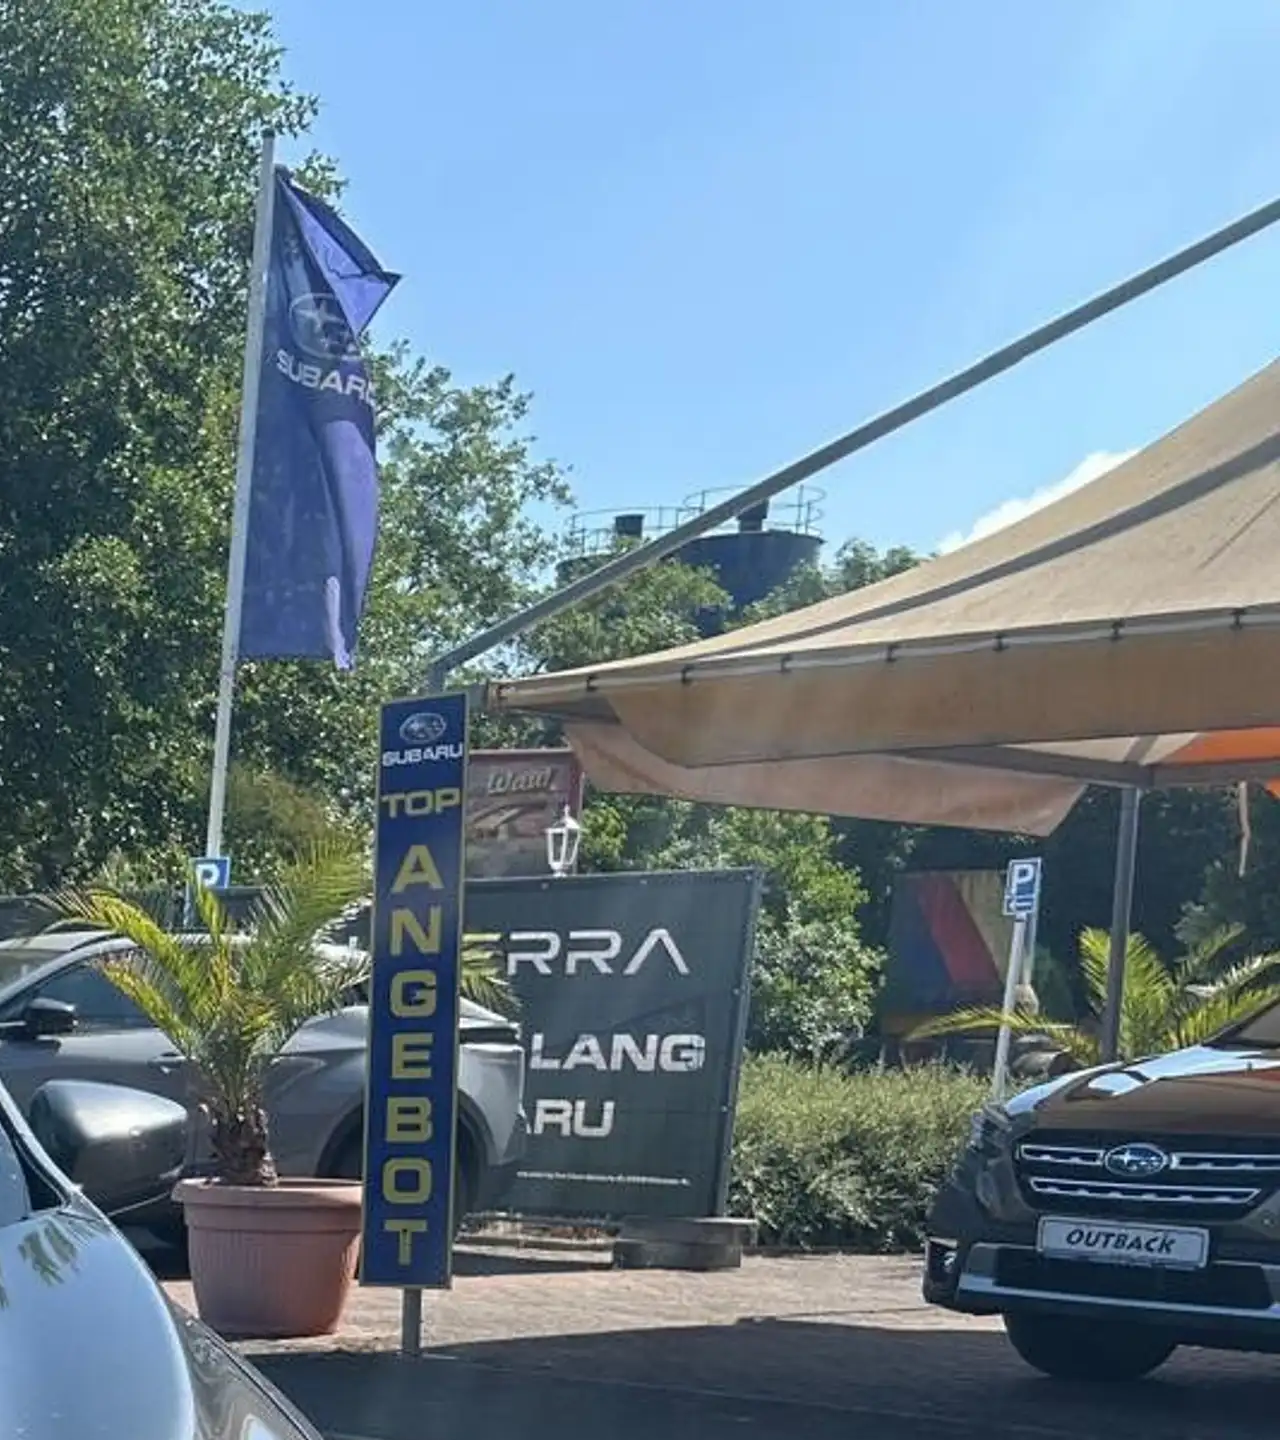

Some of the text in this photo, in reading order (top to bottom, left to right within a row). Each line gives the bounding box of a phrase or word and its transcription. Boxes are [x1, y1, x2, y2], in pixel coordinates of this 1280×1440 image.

[382, 743, 464, 767] SUBARU
[381, 786, 462, 819] TOP
[195, 863, 220, 892] P
[1011, 863, 1035, 895] P
[381, 844, 446, 1267] ANGEBOT
[529, 1032, 707, 1073] LANG
[522, 1098, 615, 1138] RU
[1065, 1227, 1176, 1255] OUTBACK
